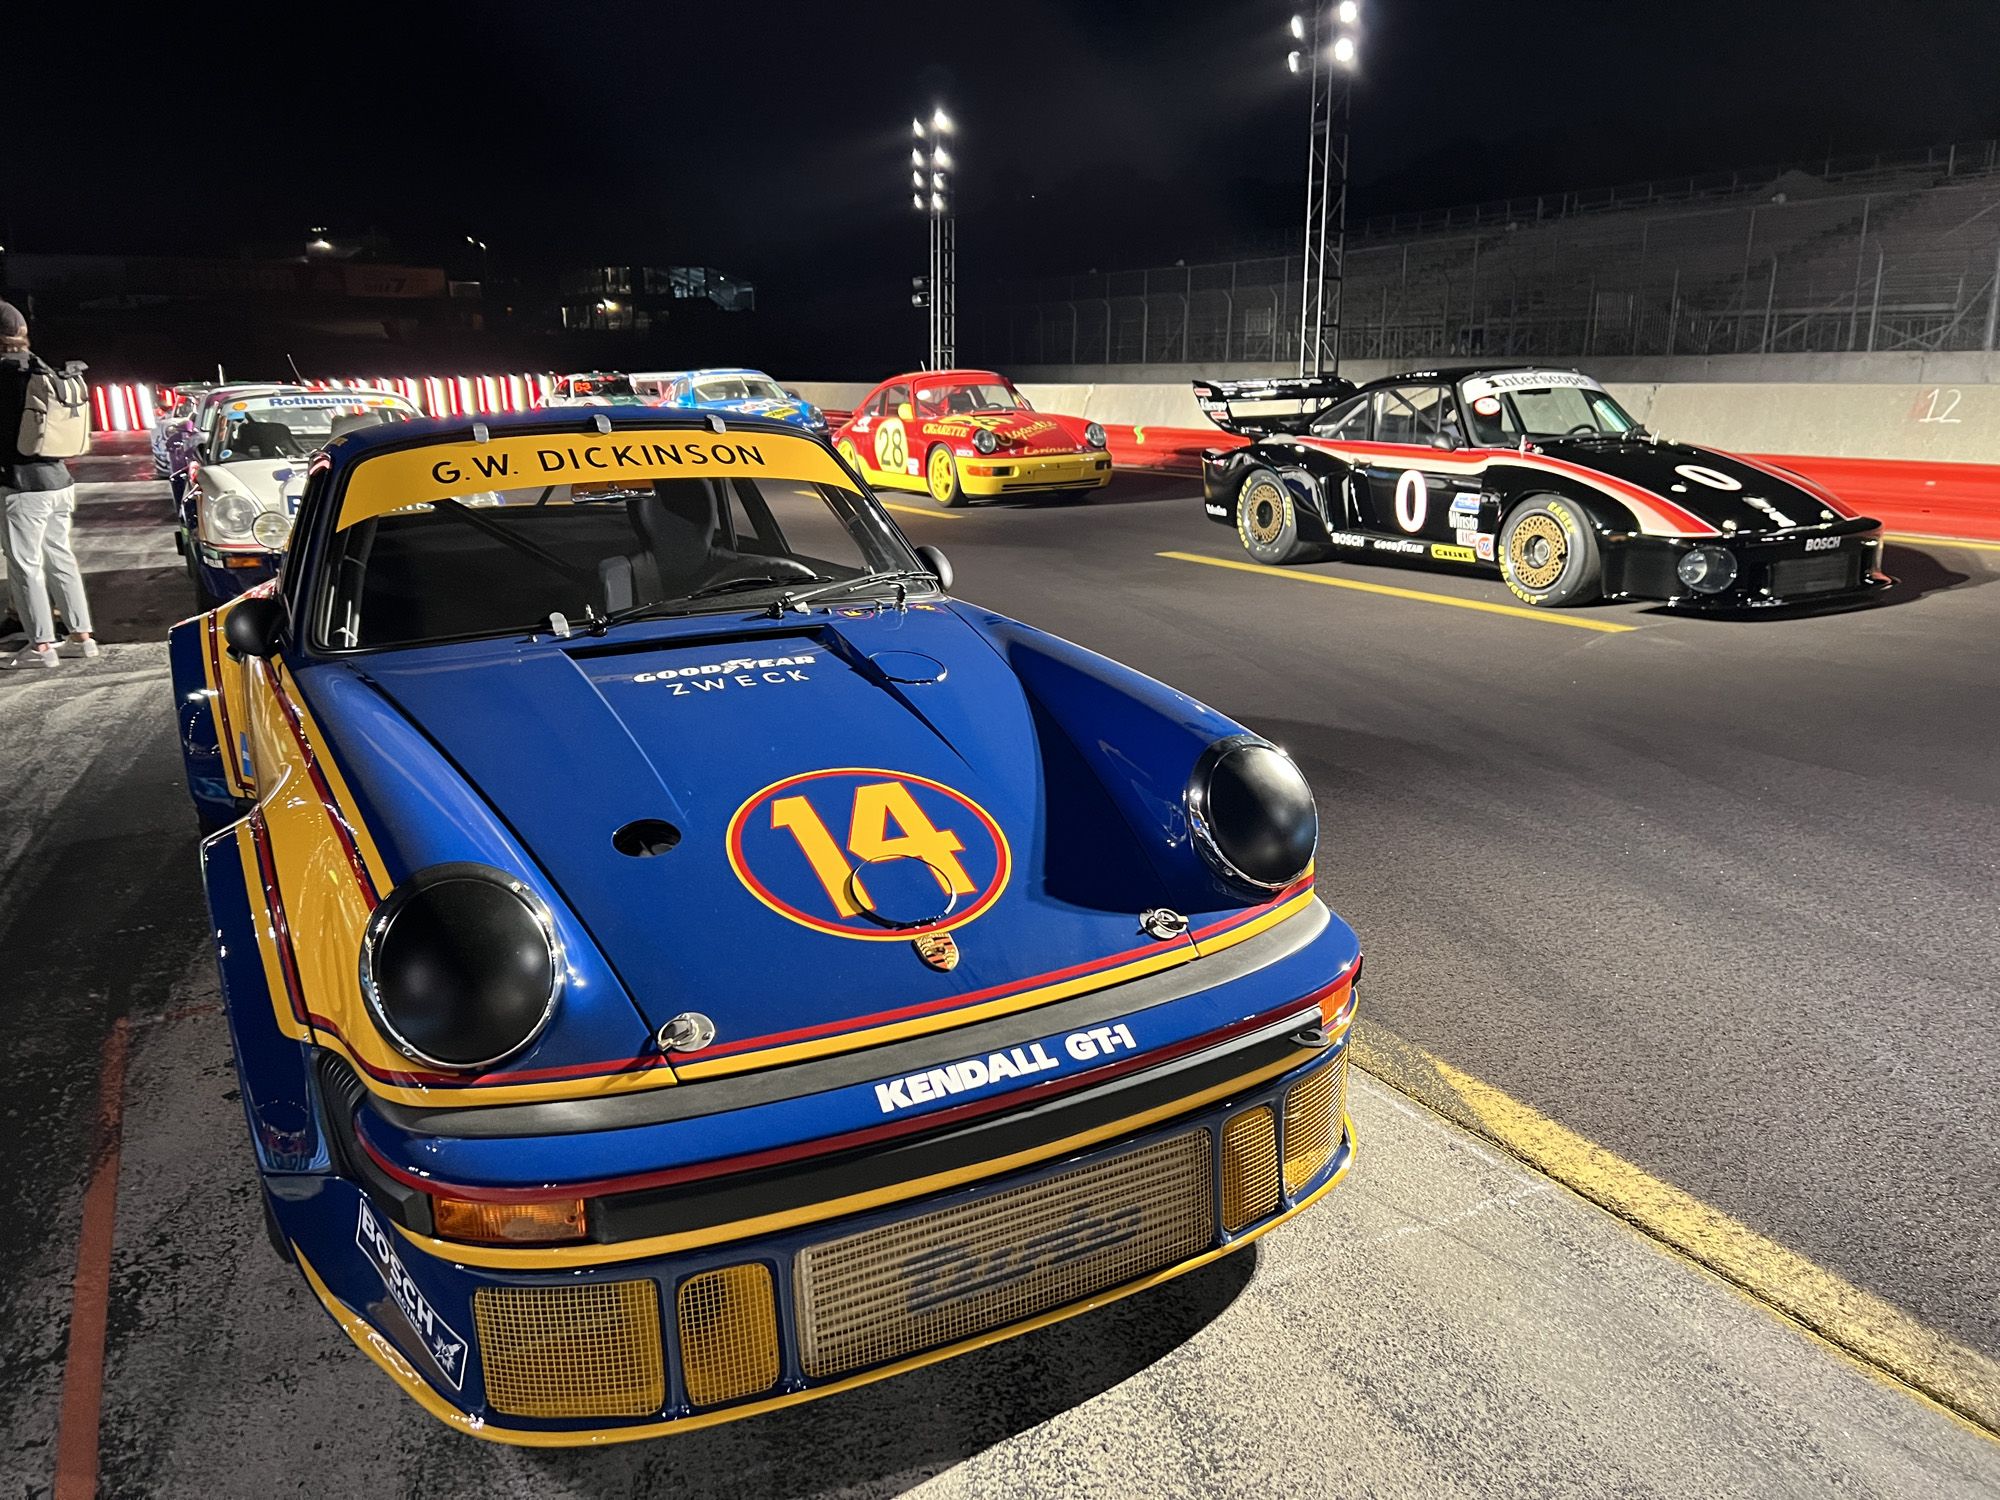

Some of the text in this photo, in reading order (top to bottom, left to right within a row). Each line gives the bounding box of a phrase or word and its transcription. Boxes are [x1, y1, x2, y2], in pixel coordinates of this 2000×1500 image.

[269, 396, 363, 408] Rothmans
[1919, 389, 1961, 423] 12
[922, 423, 970, 438] CIGARETTE
[879, 427, 904, 468] 28
[432, 444, 766, 484] G.W. DICKINSON
[1674, 464, 1742, 491] 0
[1395, 469, 1427, 533] 0
[1449, 509, 1479, 531] Winsto
[1547, 501, 1577, 535] EAGLE
[1331, 533, 1365, 548] BOSCH
[1805, 536, 1841, 552] BOSCH
[633, 656, 816, 683] GOODYEAR
[666, 669, 810, 696] ZWECK
[771, 781, 977, 918] 14
[874, 1023, 1137, 1114] KENDALL GT-1
[361, 1206, 434, 1337] BOSCH
